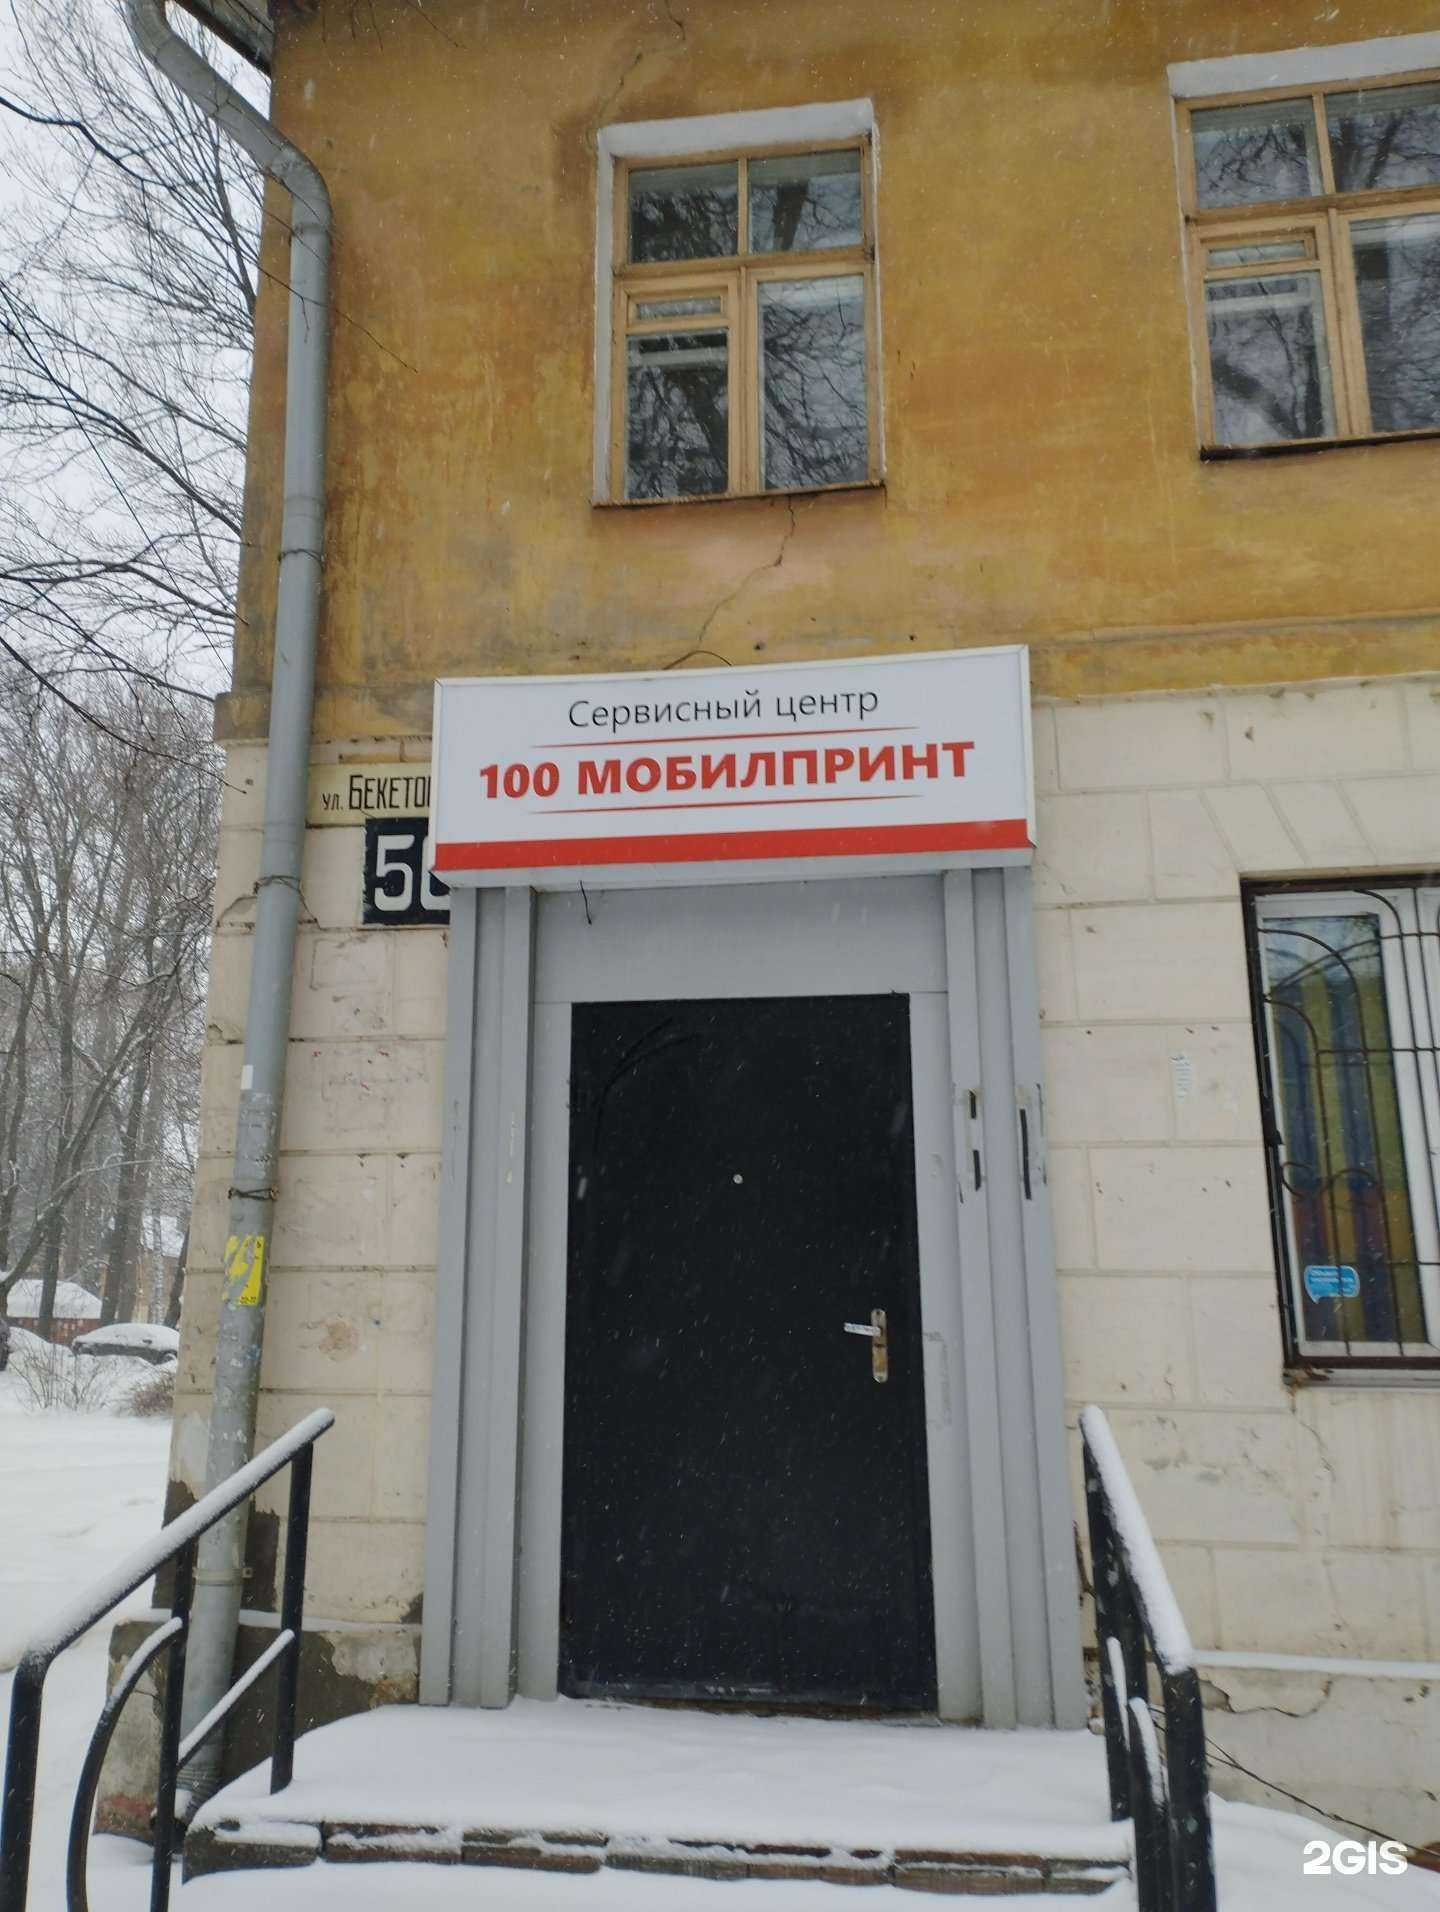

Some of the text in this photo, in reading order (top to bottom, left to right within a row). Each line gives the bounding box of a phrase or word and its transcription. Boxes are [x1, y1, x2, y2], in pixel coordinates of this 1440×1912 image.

[568, 689, 878, 734] Сервисный центр
[322, 774, 432, 811] ул. БЕКЕТО
[480, 741, 975, 799] 100 МОБИЛПРИНТ
